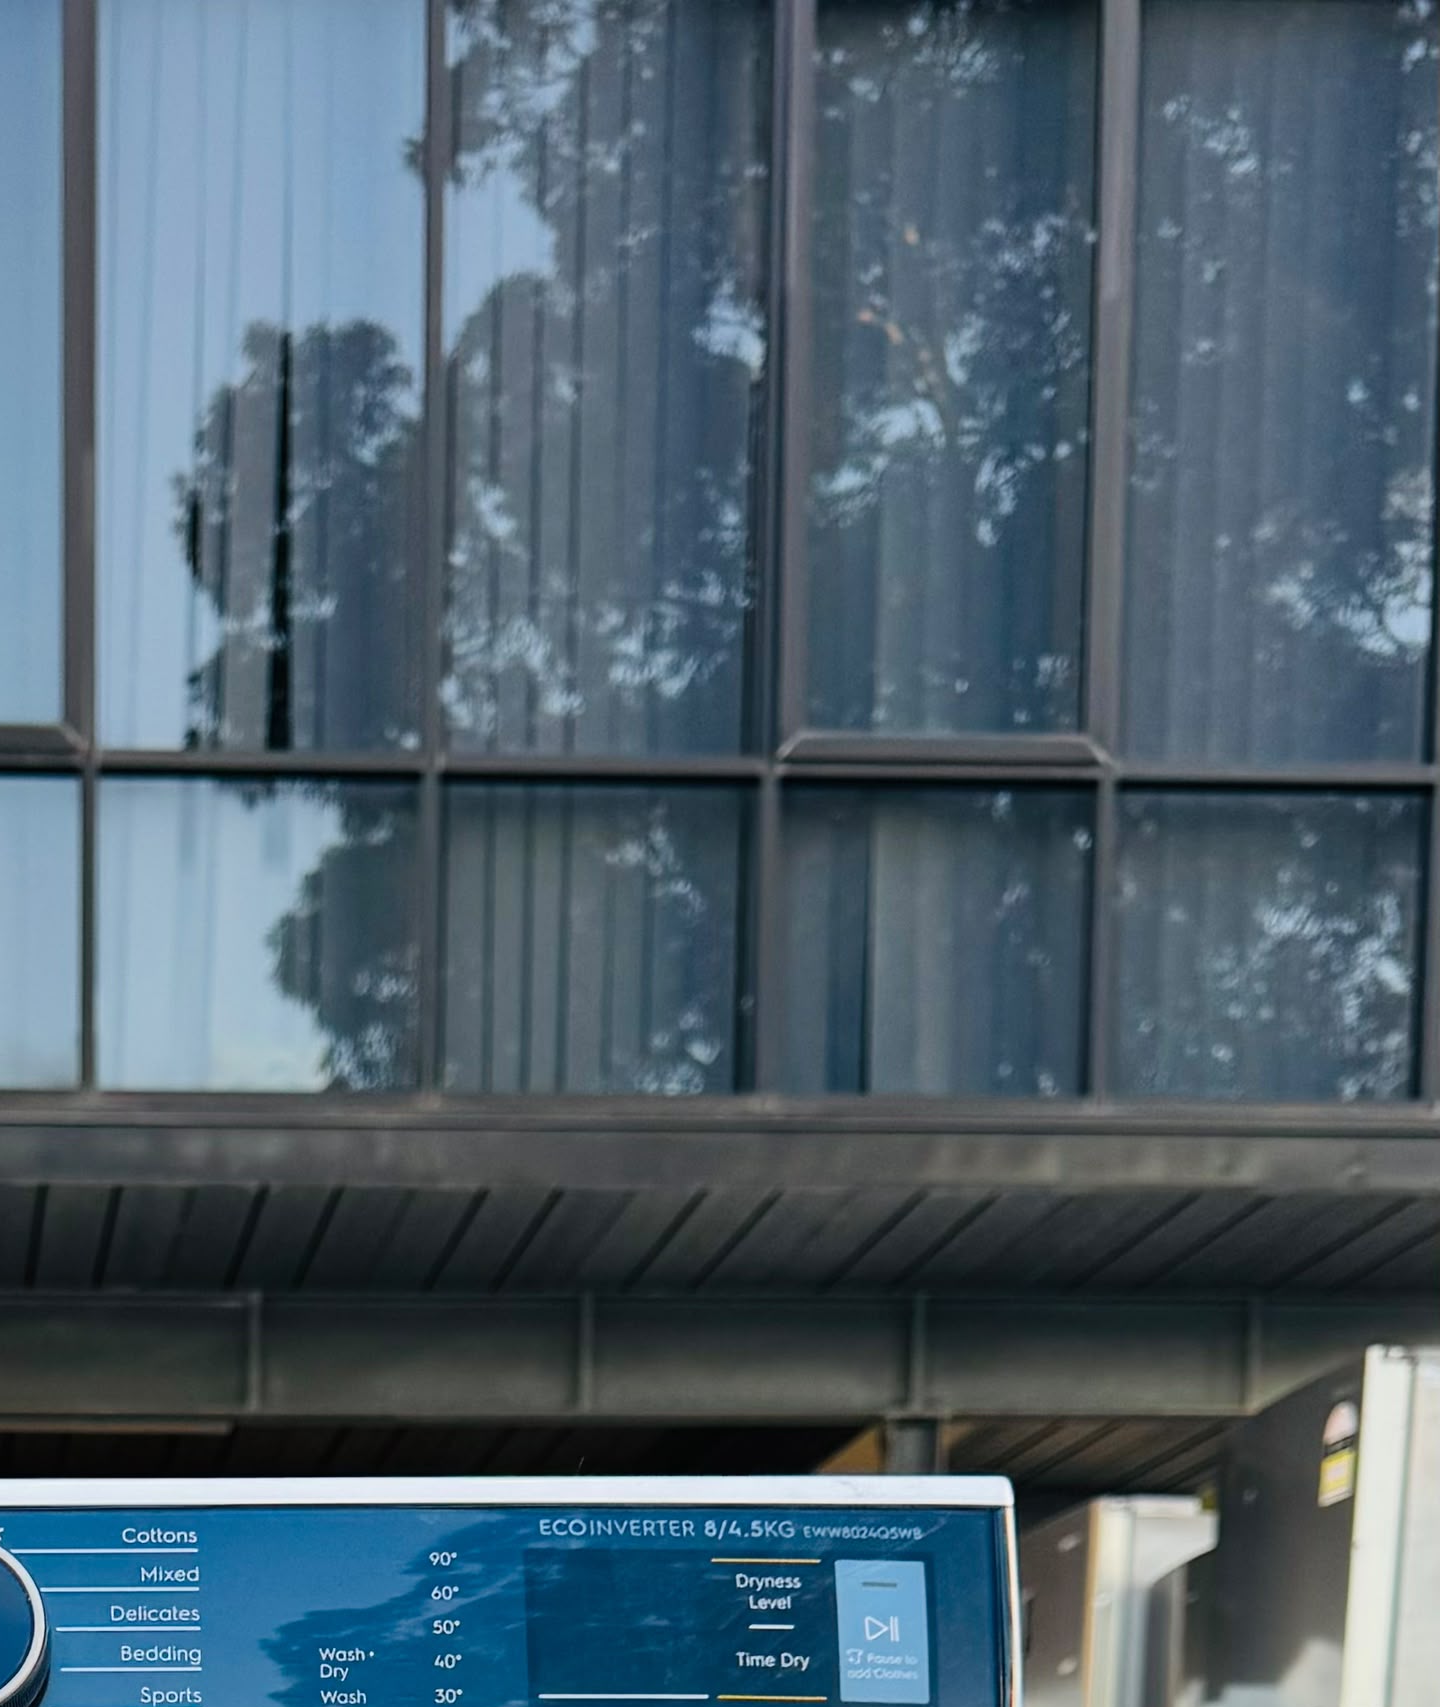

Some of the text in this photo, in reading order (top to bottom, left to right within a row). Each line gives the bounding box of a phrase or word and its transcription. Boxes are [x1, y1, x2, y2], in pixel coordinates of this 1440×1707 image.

[121, 1528, 198, 1544] Cottons
[539, 1519, 695, 1537] ECOINVERTER
[704, 1519, 795, 1540] 8/4.5KG
[429, 1551, 458, 1567] 90°
[140, 1566, 200, 1583] Mixed
[735, 1573, 802, 1590] Dryness
[430, 1585, 460, 1601] 60°
[749, 1595, 792, 1610] Level
[110, 1606, 201, 1623] Delicates
[432, 1619, 461, 1635] 50°
[120, 1645, 202, 1665] Bedding
[433, 1653, 462, 1669] 40°
[735, 1652, 810, 1672] Time Dry
[320, 1665, 349, 1682] Dry
[140, 1687, 202, 1707] Sports
[321, 1690, 367, 1705] Wash
[434, 1688, 463, 1704] 30°
